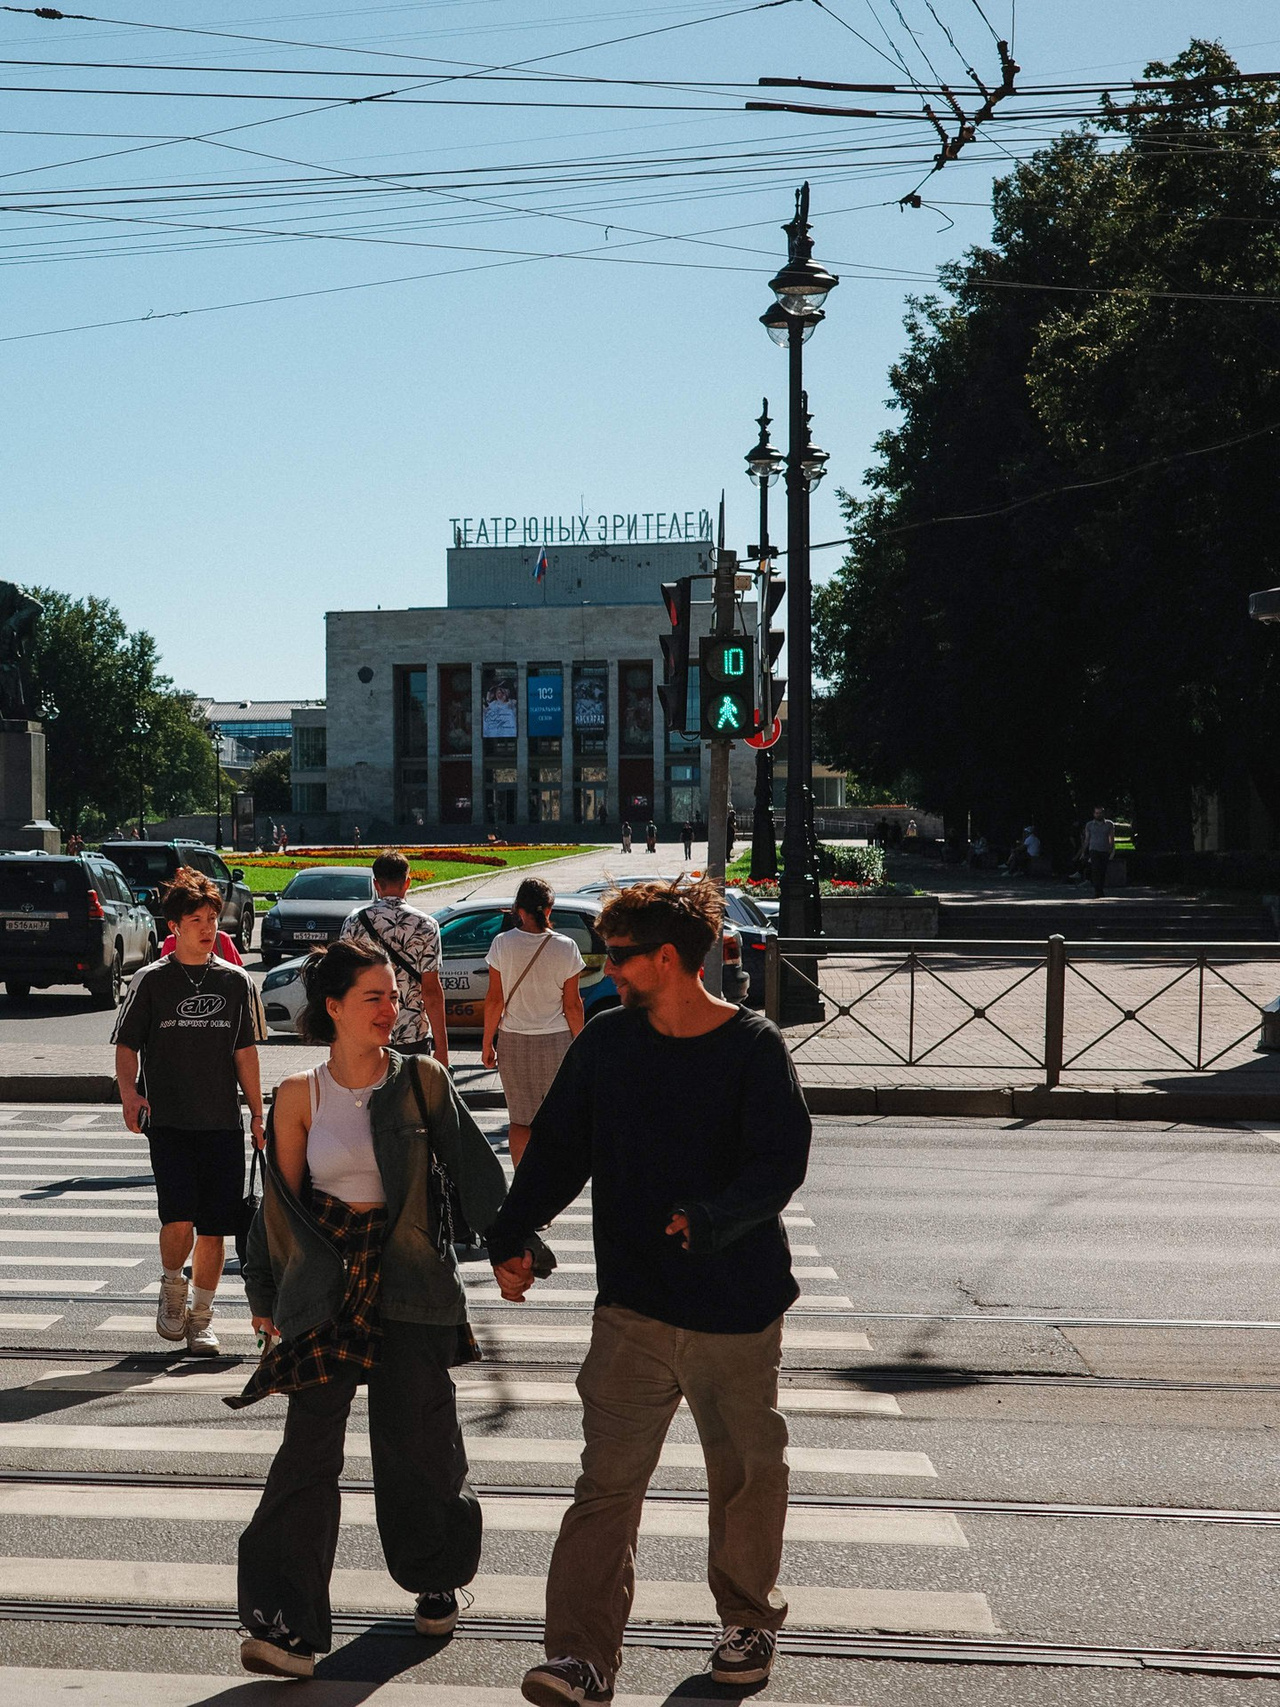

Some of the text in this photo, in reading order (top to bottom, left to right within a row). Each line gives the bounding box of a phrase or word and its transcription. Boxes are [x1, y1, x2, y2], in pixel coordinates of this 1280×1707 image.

[449, 509, 710, 545] ТЕАТР ЮНЫХ ЗРИТЕЛЕЙ
[724, 648, 744, 675] 10
[177, 1020, 209, 1028] SPIKY
